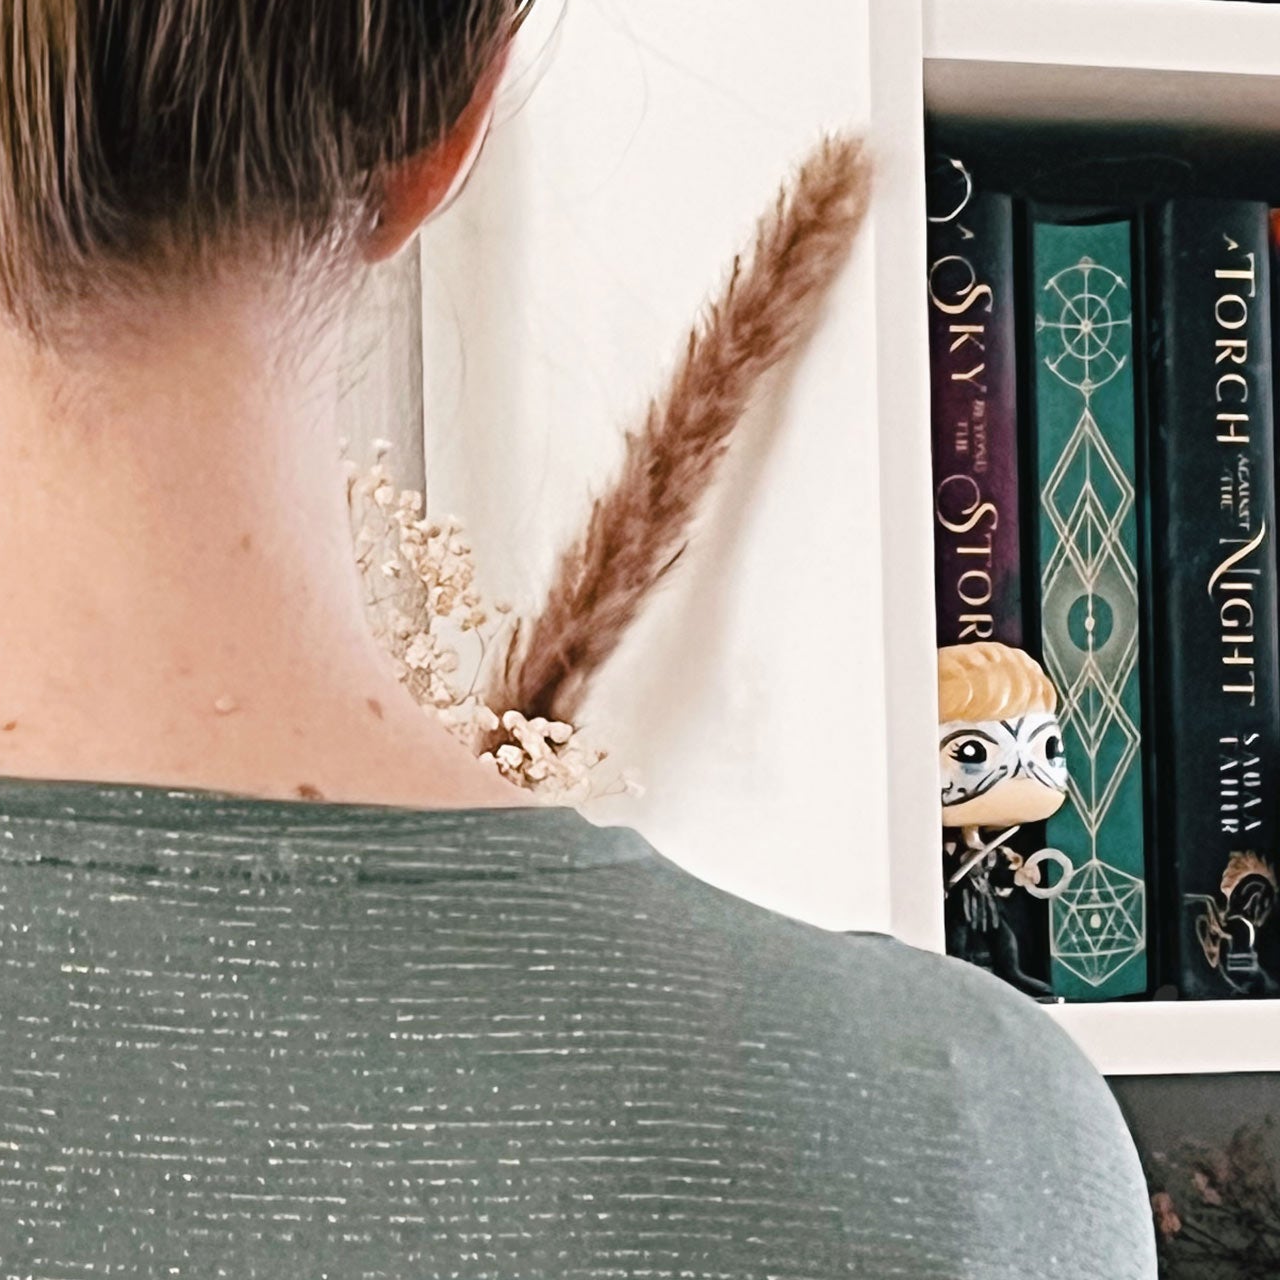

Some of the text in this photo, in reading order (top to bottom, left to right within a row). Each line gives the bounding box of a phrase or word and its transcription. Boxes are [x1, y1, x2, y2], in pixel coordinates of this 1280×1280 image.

[928, 254, 993, 394] SKY
[1214, 252, 1256, 444] TORCH
[937, 474, 999, 639] STOR
[1207, 520, 1266, 708] NIGHT
